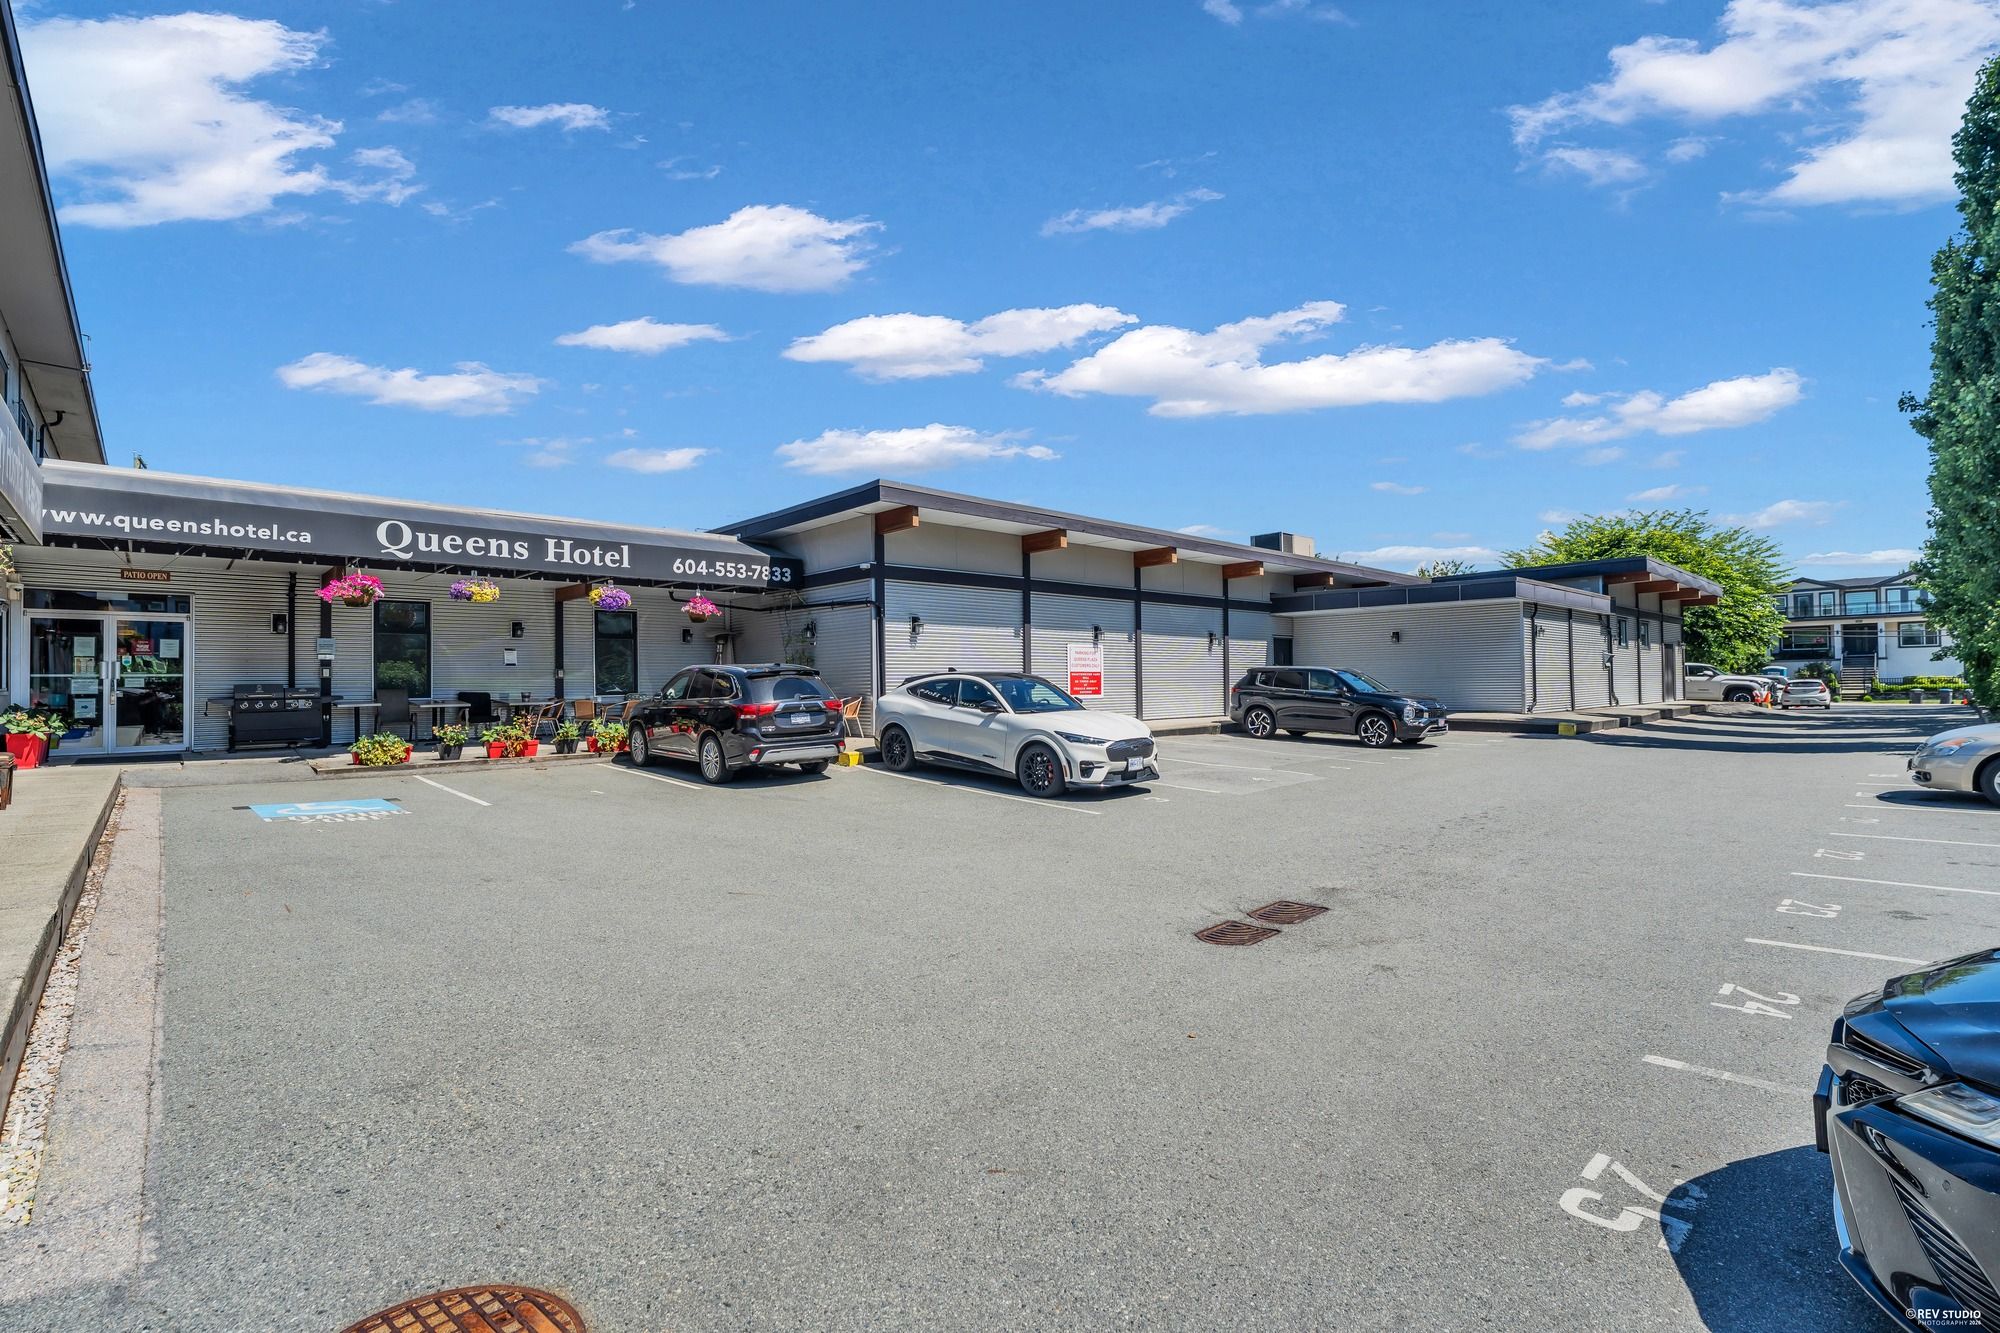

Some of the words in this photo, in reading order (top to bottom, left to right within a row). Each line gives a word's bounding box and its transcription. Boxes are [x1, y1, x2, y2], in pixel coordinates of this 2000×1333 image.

[376, 520, 529, 560] Queens
[544, 538, 631, 568] Hotel
[123, 570, 146, 579] PATIO
[147, 572, 168, 580] OPEN
[672, 558, 792, 582] 604-553-7833
[1814, 848, 1865, 861] 22
[1776, 898, 1842, 918] 23
[1710, 982, 1801, 1020] 24
[1558, 1152, 1708, 1254] 25
